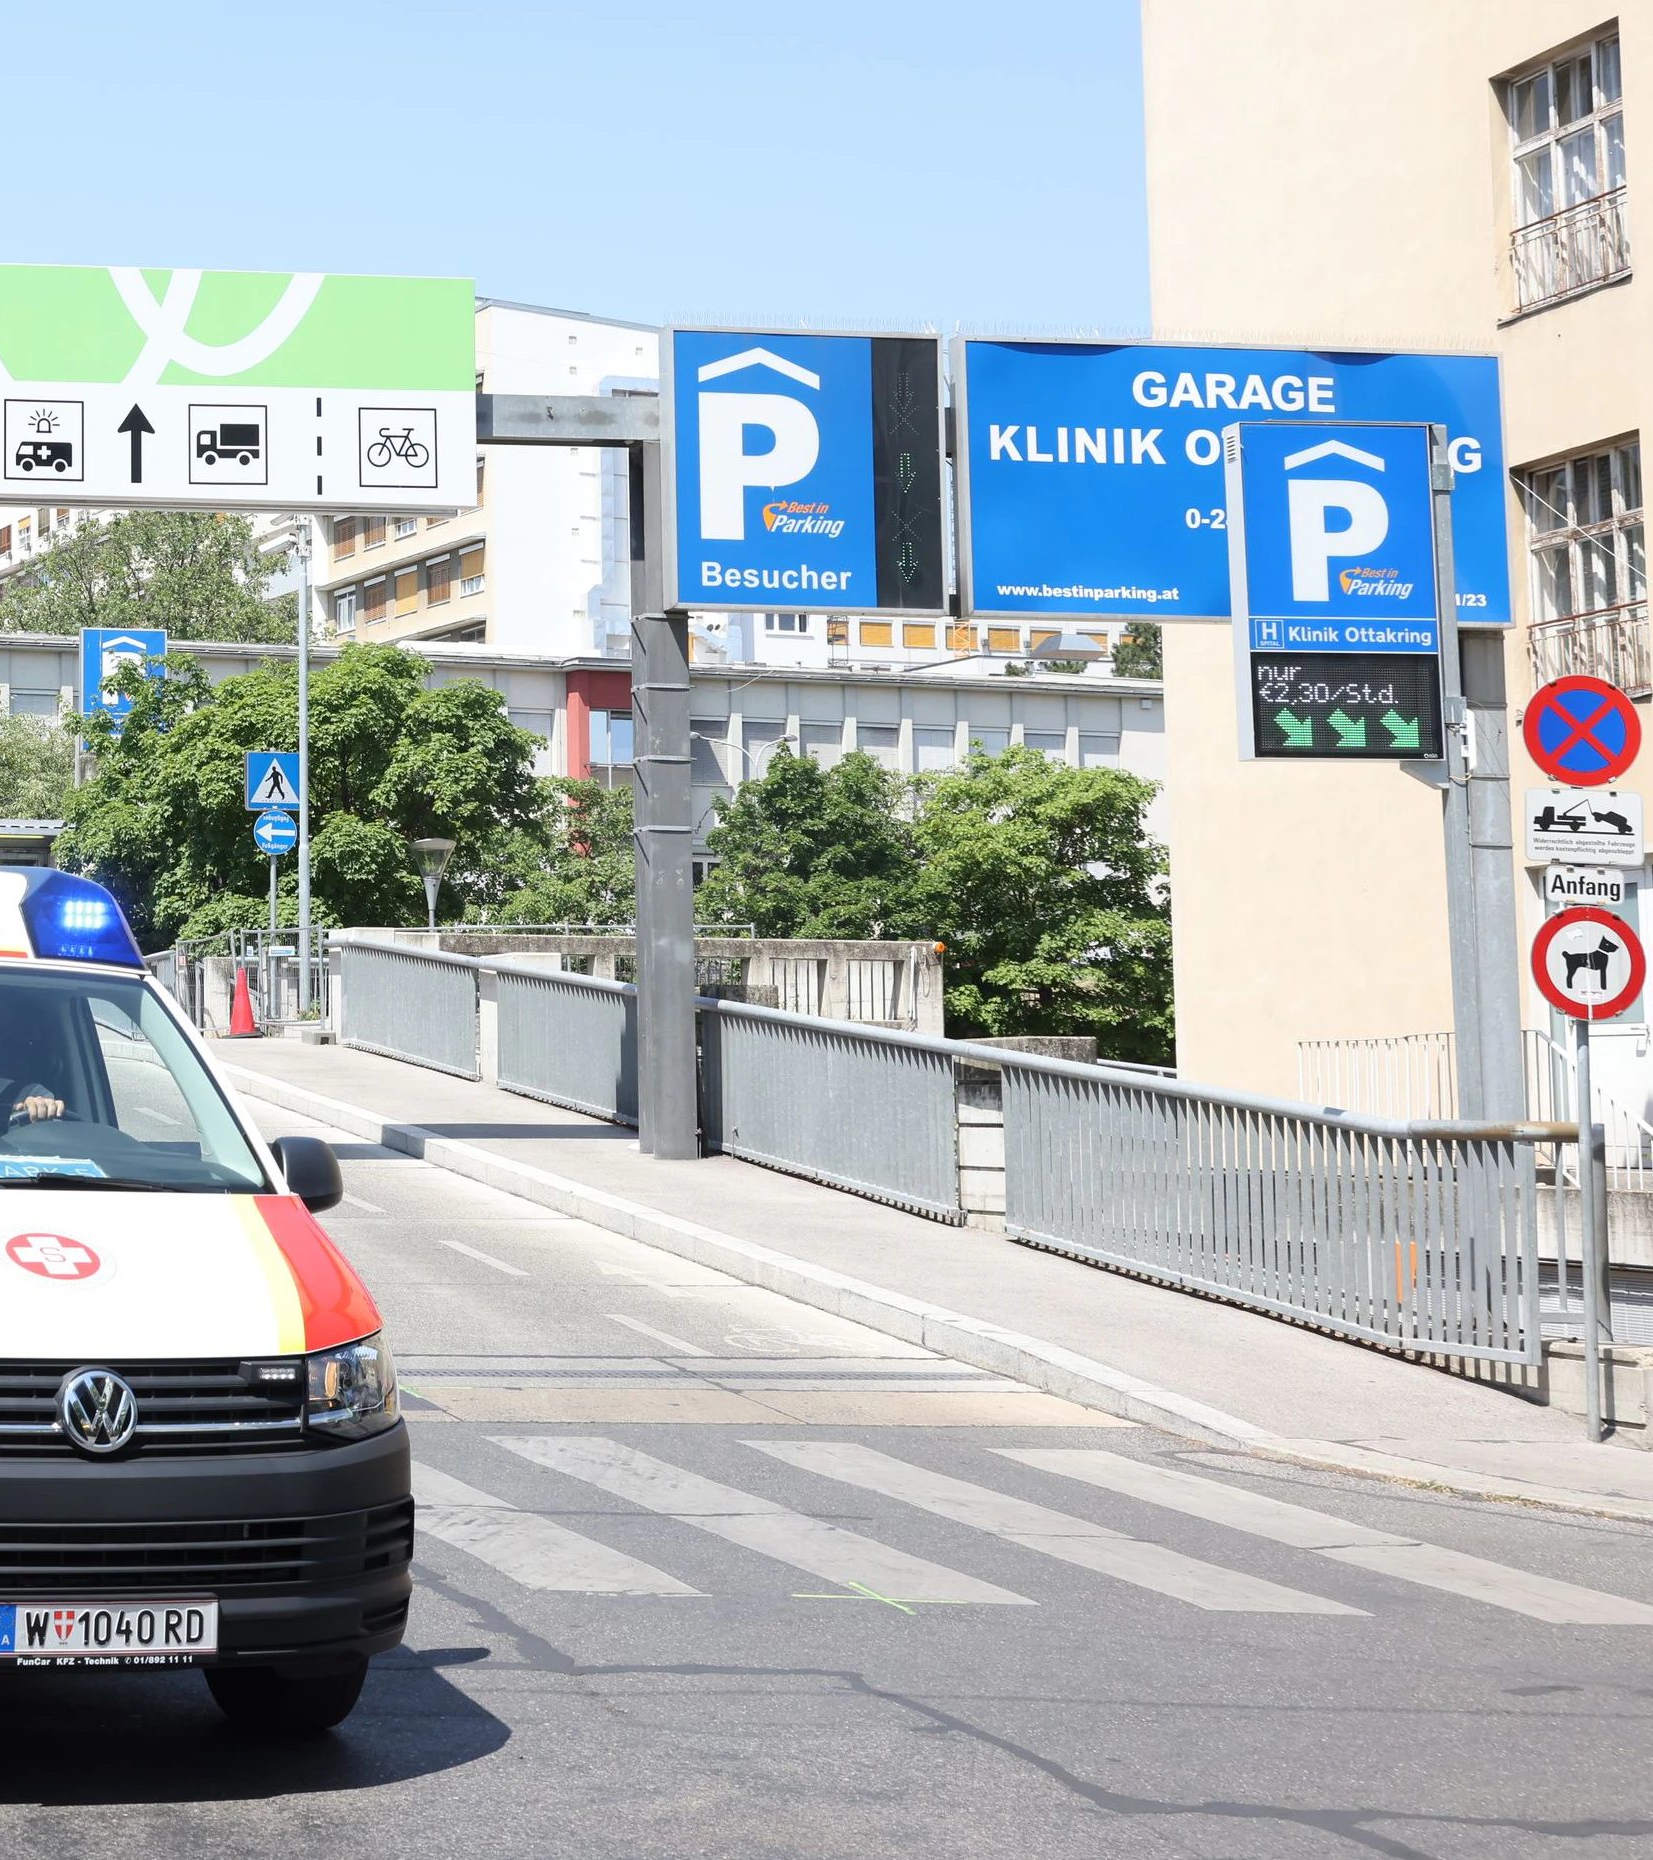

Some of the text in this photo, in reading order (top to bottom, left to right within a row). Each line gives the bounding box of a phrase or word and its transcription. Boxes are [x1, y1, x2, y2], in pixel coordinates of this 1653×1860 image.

[1132, 371, 1336, 413] GARAGE
[989, 424, 1166, 465] KLINIK
[698, 391, 820, 540] P
[786, 501, 830, 514] Best in
[771, 515, 845, 538] Parking
[1185, 508, 1229, 529] 0-2
[1287, 479, 1389, 602] P
[701, 561, 852, 590] Besucher
[1361, 567, 1399, 578] Best in
[997, 584, 1179, 603] www.bestinparking.at
[1347, 579, 1414, 599] Parking
[1261, 622, 1278, 640] H
[1288, 626, 1432, 646] Klinik Ottakring
[1258, 666, 1301, 681] nur
[1258, 683, 1399, 705] €2,30/Std.
[1551, 874, 1621, 902] Anfang
[25, 1610, 49, 1647] W
[77, 1609, 155, 1646] 1040
[164, 1609, 204, 1645] RD
[17, 1657, 51, 1666] FunCar
[56, 1657, 75, 1665] KFZ
[84, 1657, 119, 1665] Technik
[133, 1655, 166, 1664] 01/892
[169, 1655, 179, 1664] 11
[182, 1655, 193, 1663] 11
